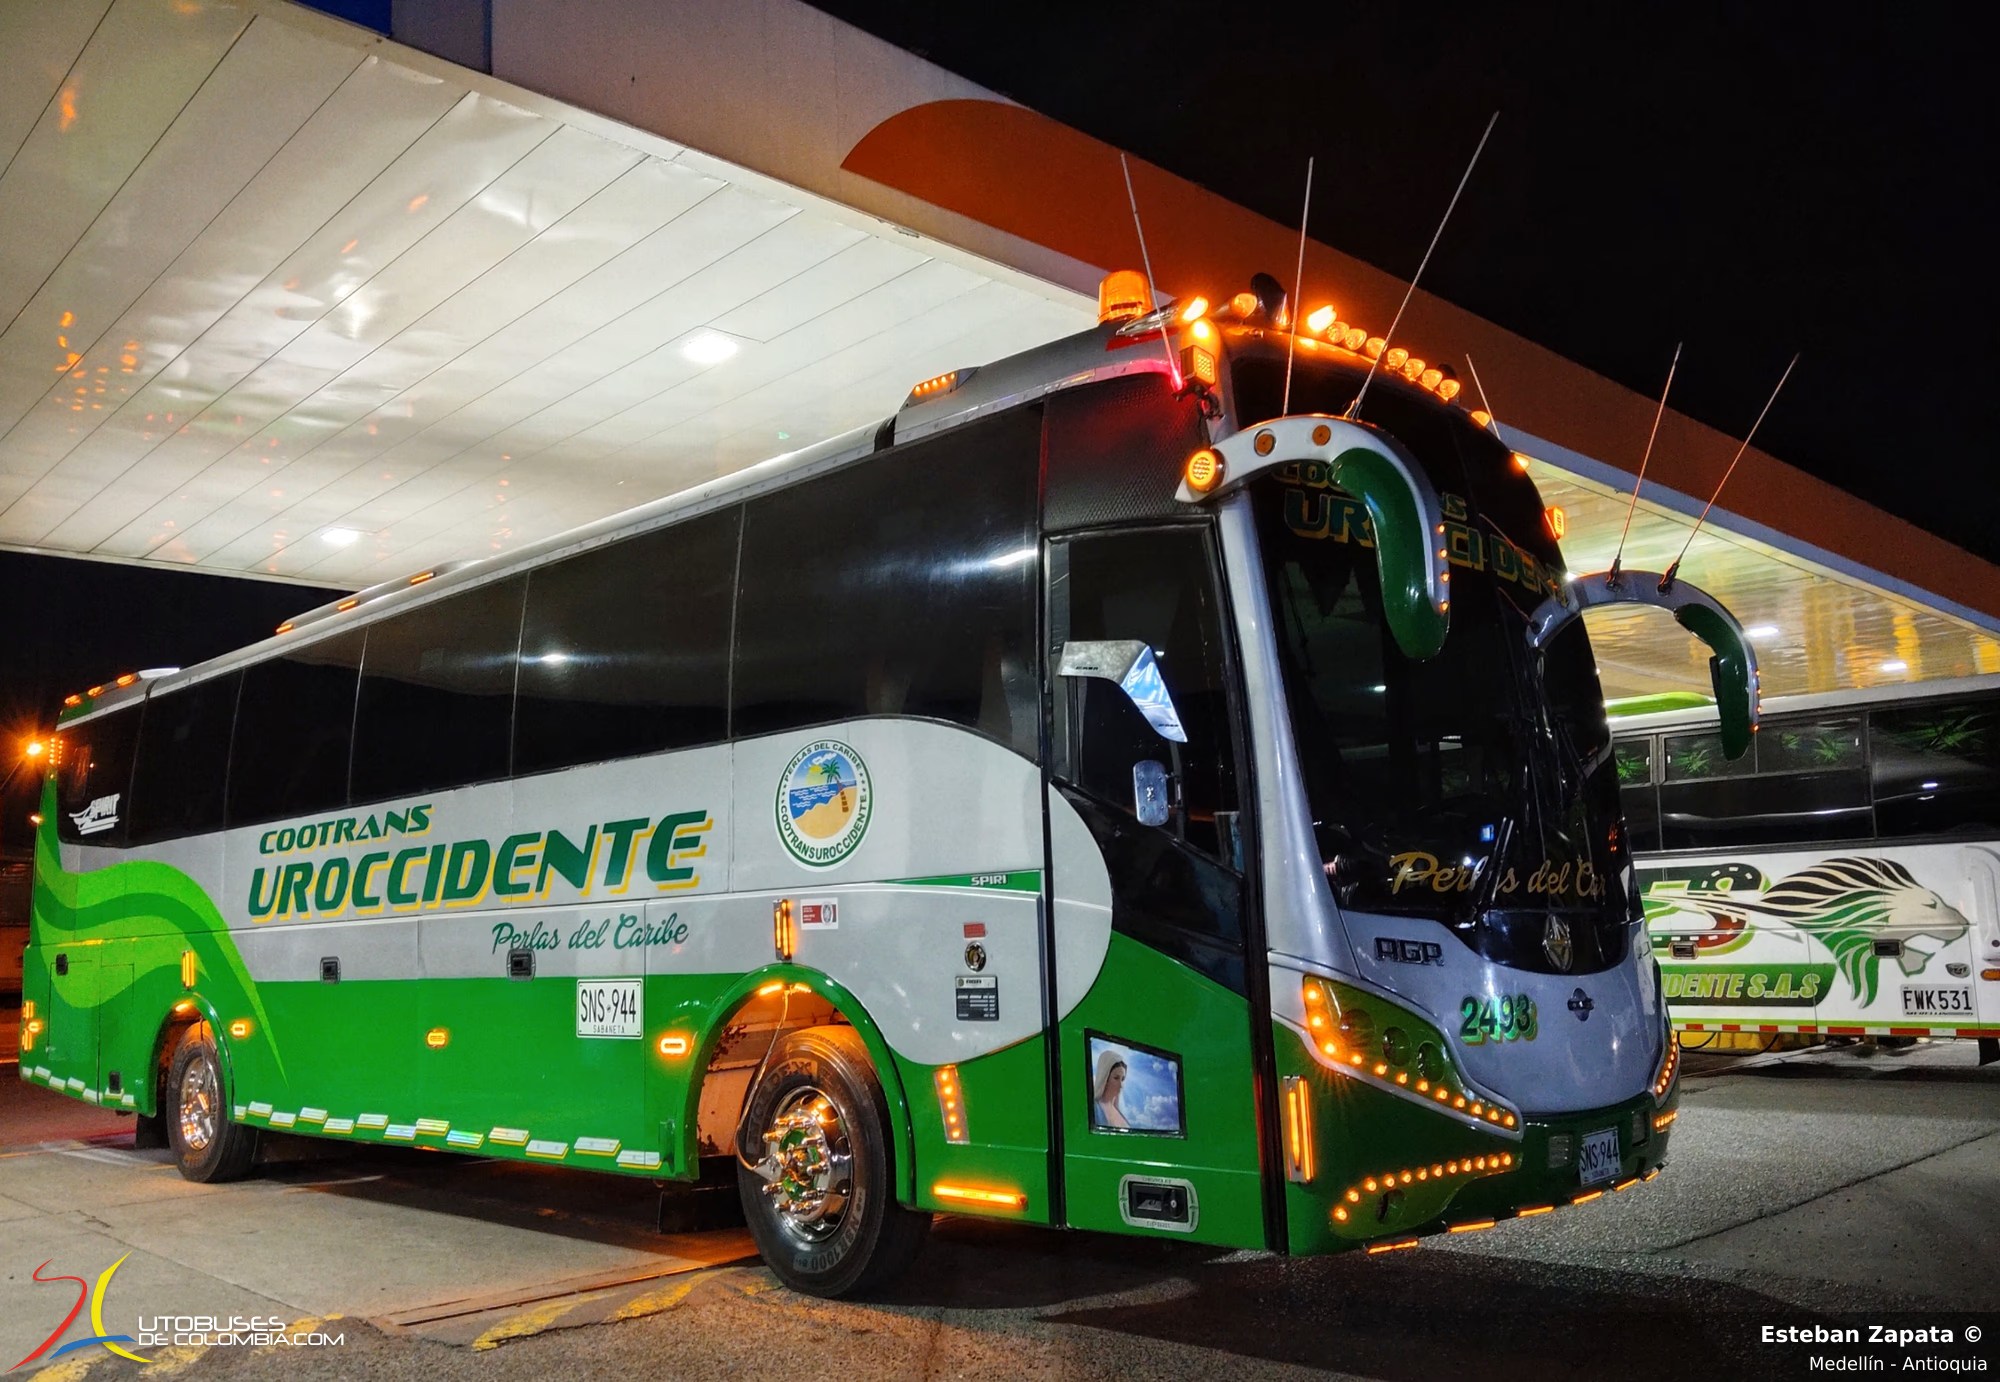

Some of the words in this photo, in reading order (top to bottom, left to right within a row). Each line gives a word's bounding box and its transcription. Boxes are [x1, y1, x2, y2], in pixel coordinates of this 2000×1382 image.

[786, 747, 812, 782] PERLAS
[814, 743, 830, 751] DEL
[832, 743, 861, 770] CARIBE
[259, 804, 433, 856] COOTRANS
[780, 795, 867, 860] COOTRANSUROCCIDENTE
[247, 810, 713, 924] UROCCIDENTE
[971, 875, 1007, 887] SPIRI
[1389, 851, 1520, 895] Perls
[1527, 859, 1571, 894] del
[492, 922, 562, 955] Perlas
[569, 919, 606, 949] del
[612, 912, 689, 949] Caribe
[1662, 973, 1745, 998] IDENTE
[1747, 973, 1821, 999] S.A.S
[1903, 990, 1972, 1010] FWK531
[593, 1025, 625, 1034] SABANETA
[1460, 994, 1538, 1045] 2493
